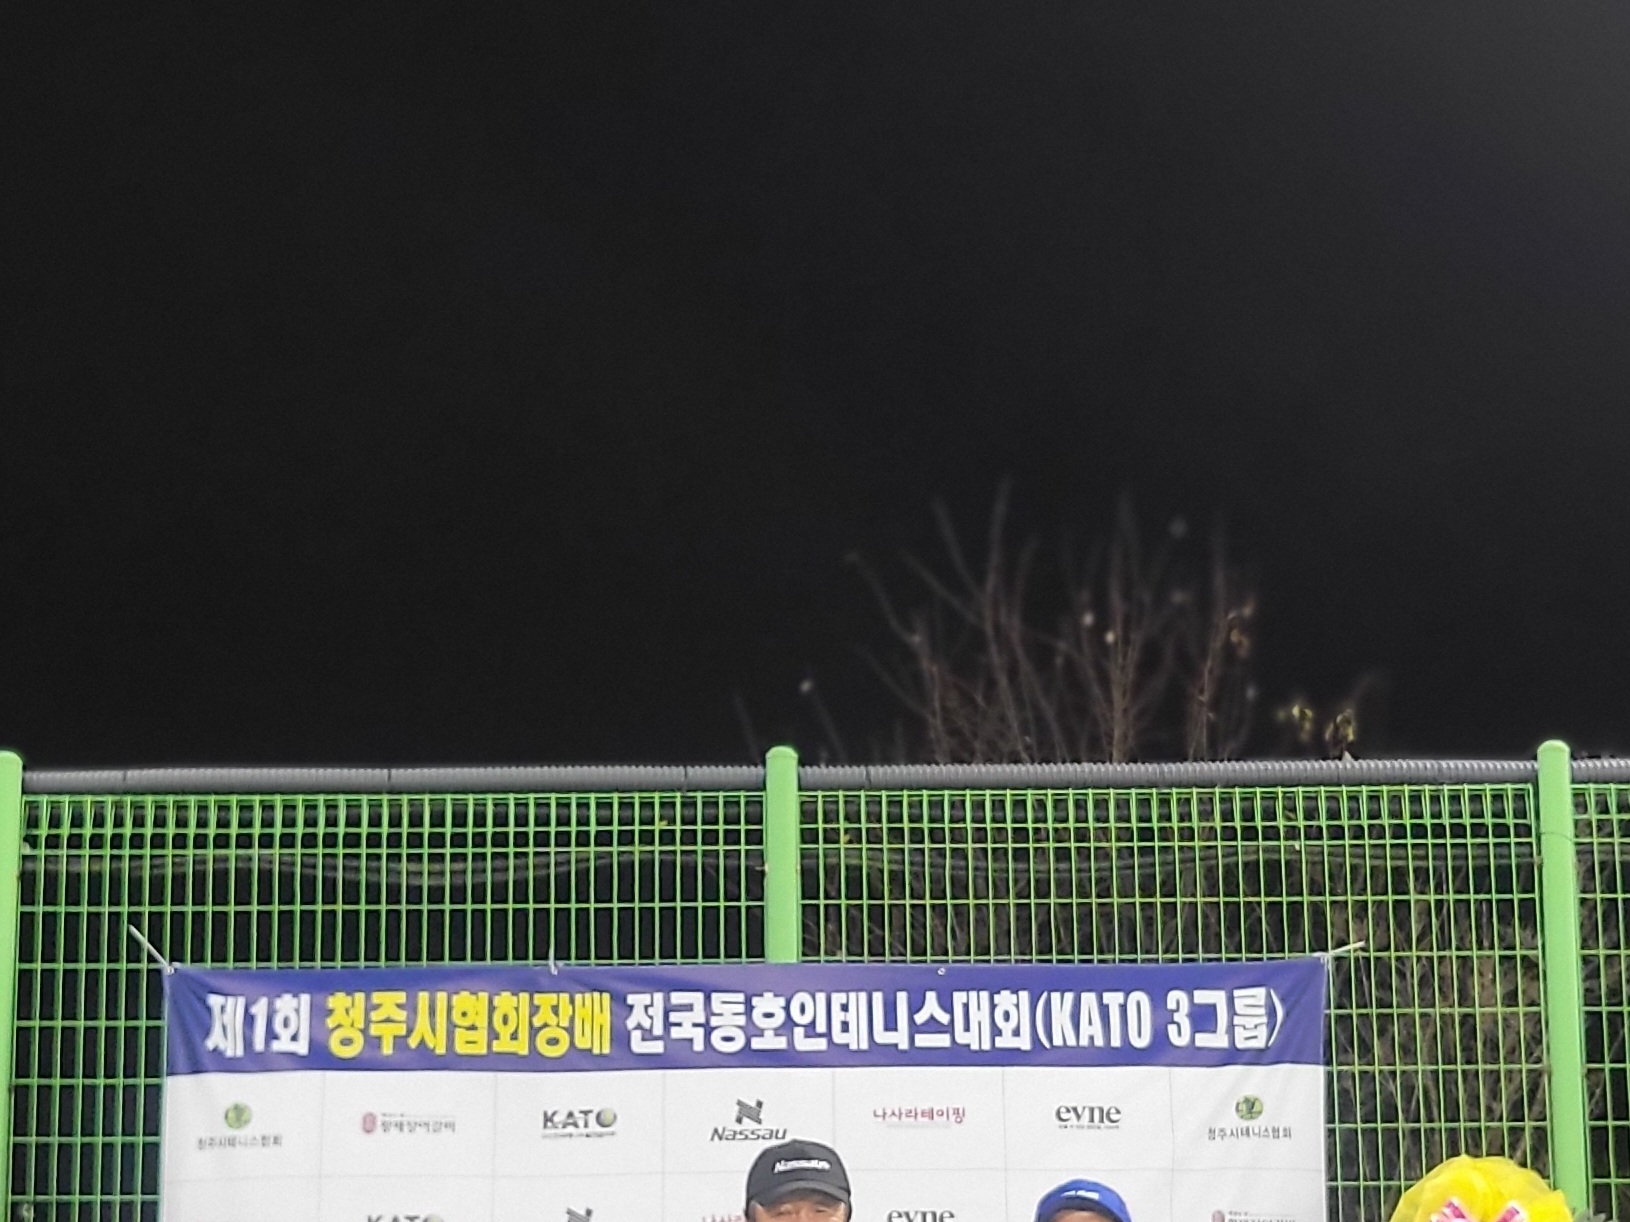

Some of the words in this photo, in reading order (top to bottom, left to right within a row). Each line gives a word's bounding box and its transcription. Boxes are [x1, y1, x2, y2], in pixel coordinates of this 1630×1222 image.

[206, 992, 311, 1057] 제1회
[326, 991, 611, 1058] 청주시협회장배
[625, 989, 1151, 1055] 전국동호인테니스대회(KATO
[1166, 986, 1285, 1049] 3그룹)
[542, 1107, 617, 1130] KATO
[873, 1106, 965, 1123] 나사라테이핑
[1055, 1104, 1122, 1124] evne
[710, 1127, 787, 1141] Nassau
[1208, 1126, 1292, 1141] 청주시테니스협회
